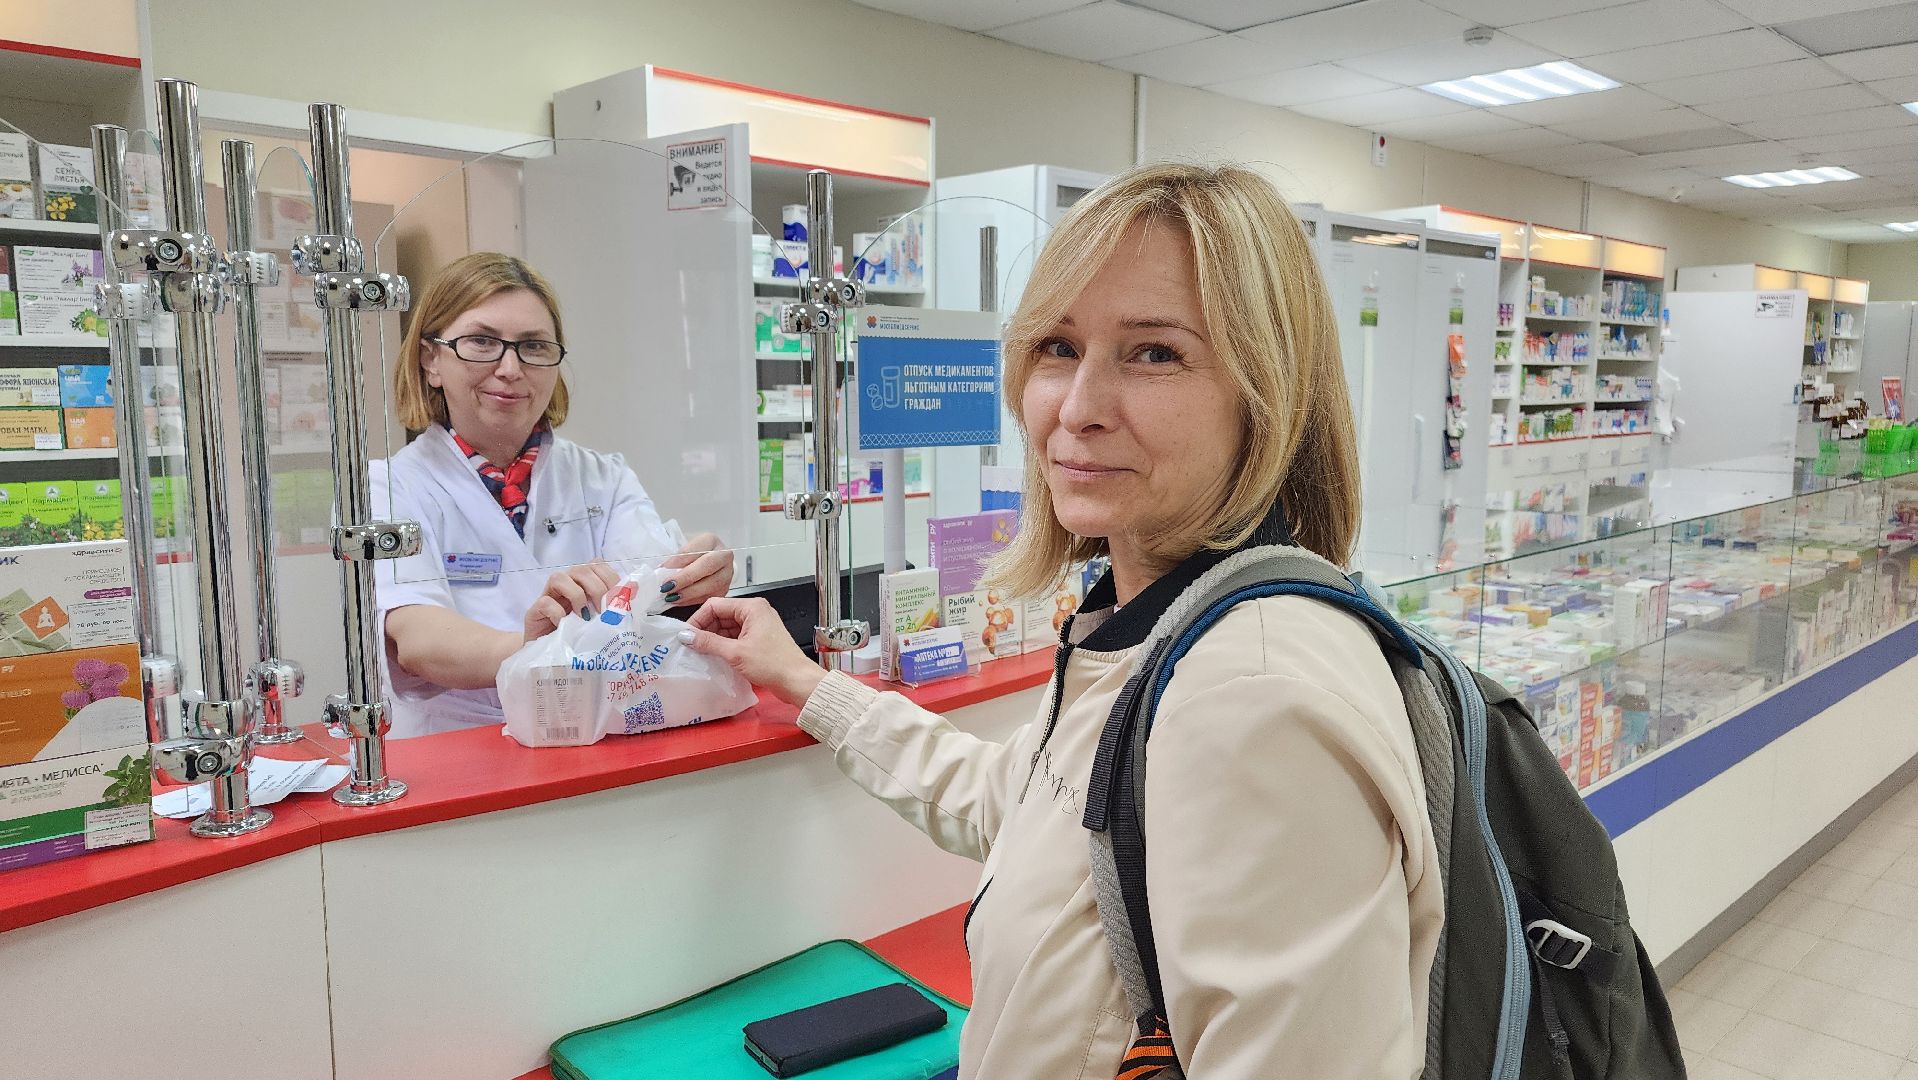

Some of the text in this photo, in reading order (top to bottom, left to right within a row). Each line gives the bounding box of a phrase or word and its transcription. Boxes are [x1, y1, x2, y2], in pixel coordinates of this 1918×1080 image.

[670, 143, 723, 159] ВНИМАНИЕ!
[904, 365, 994, 378] ОТПУСК МЕДИКАМЕНТОВ
[904, 381, 994, 394] ЛЬГОТНЫМ КАТЕГОРИЯМ
[905, 398, 941, 410] ГРАЖДАН
[895, 591, 936, 602] МИНЕРАЛЬНЫЙ
[948, 594, 975, 608] Рыбий
[895, 600, 924, 609] КОМПЛЕКС
[949, 606, 967, 616] жир
[906, 614, 912, 622] А
[907, 621, 917, 630] Zn
[42, 764, 101, 782] МЕЛИССА
